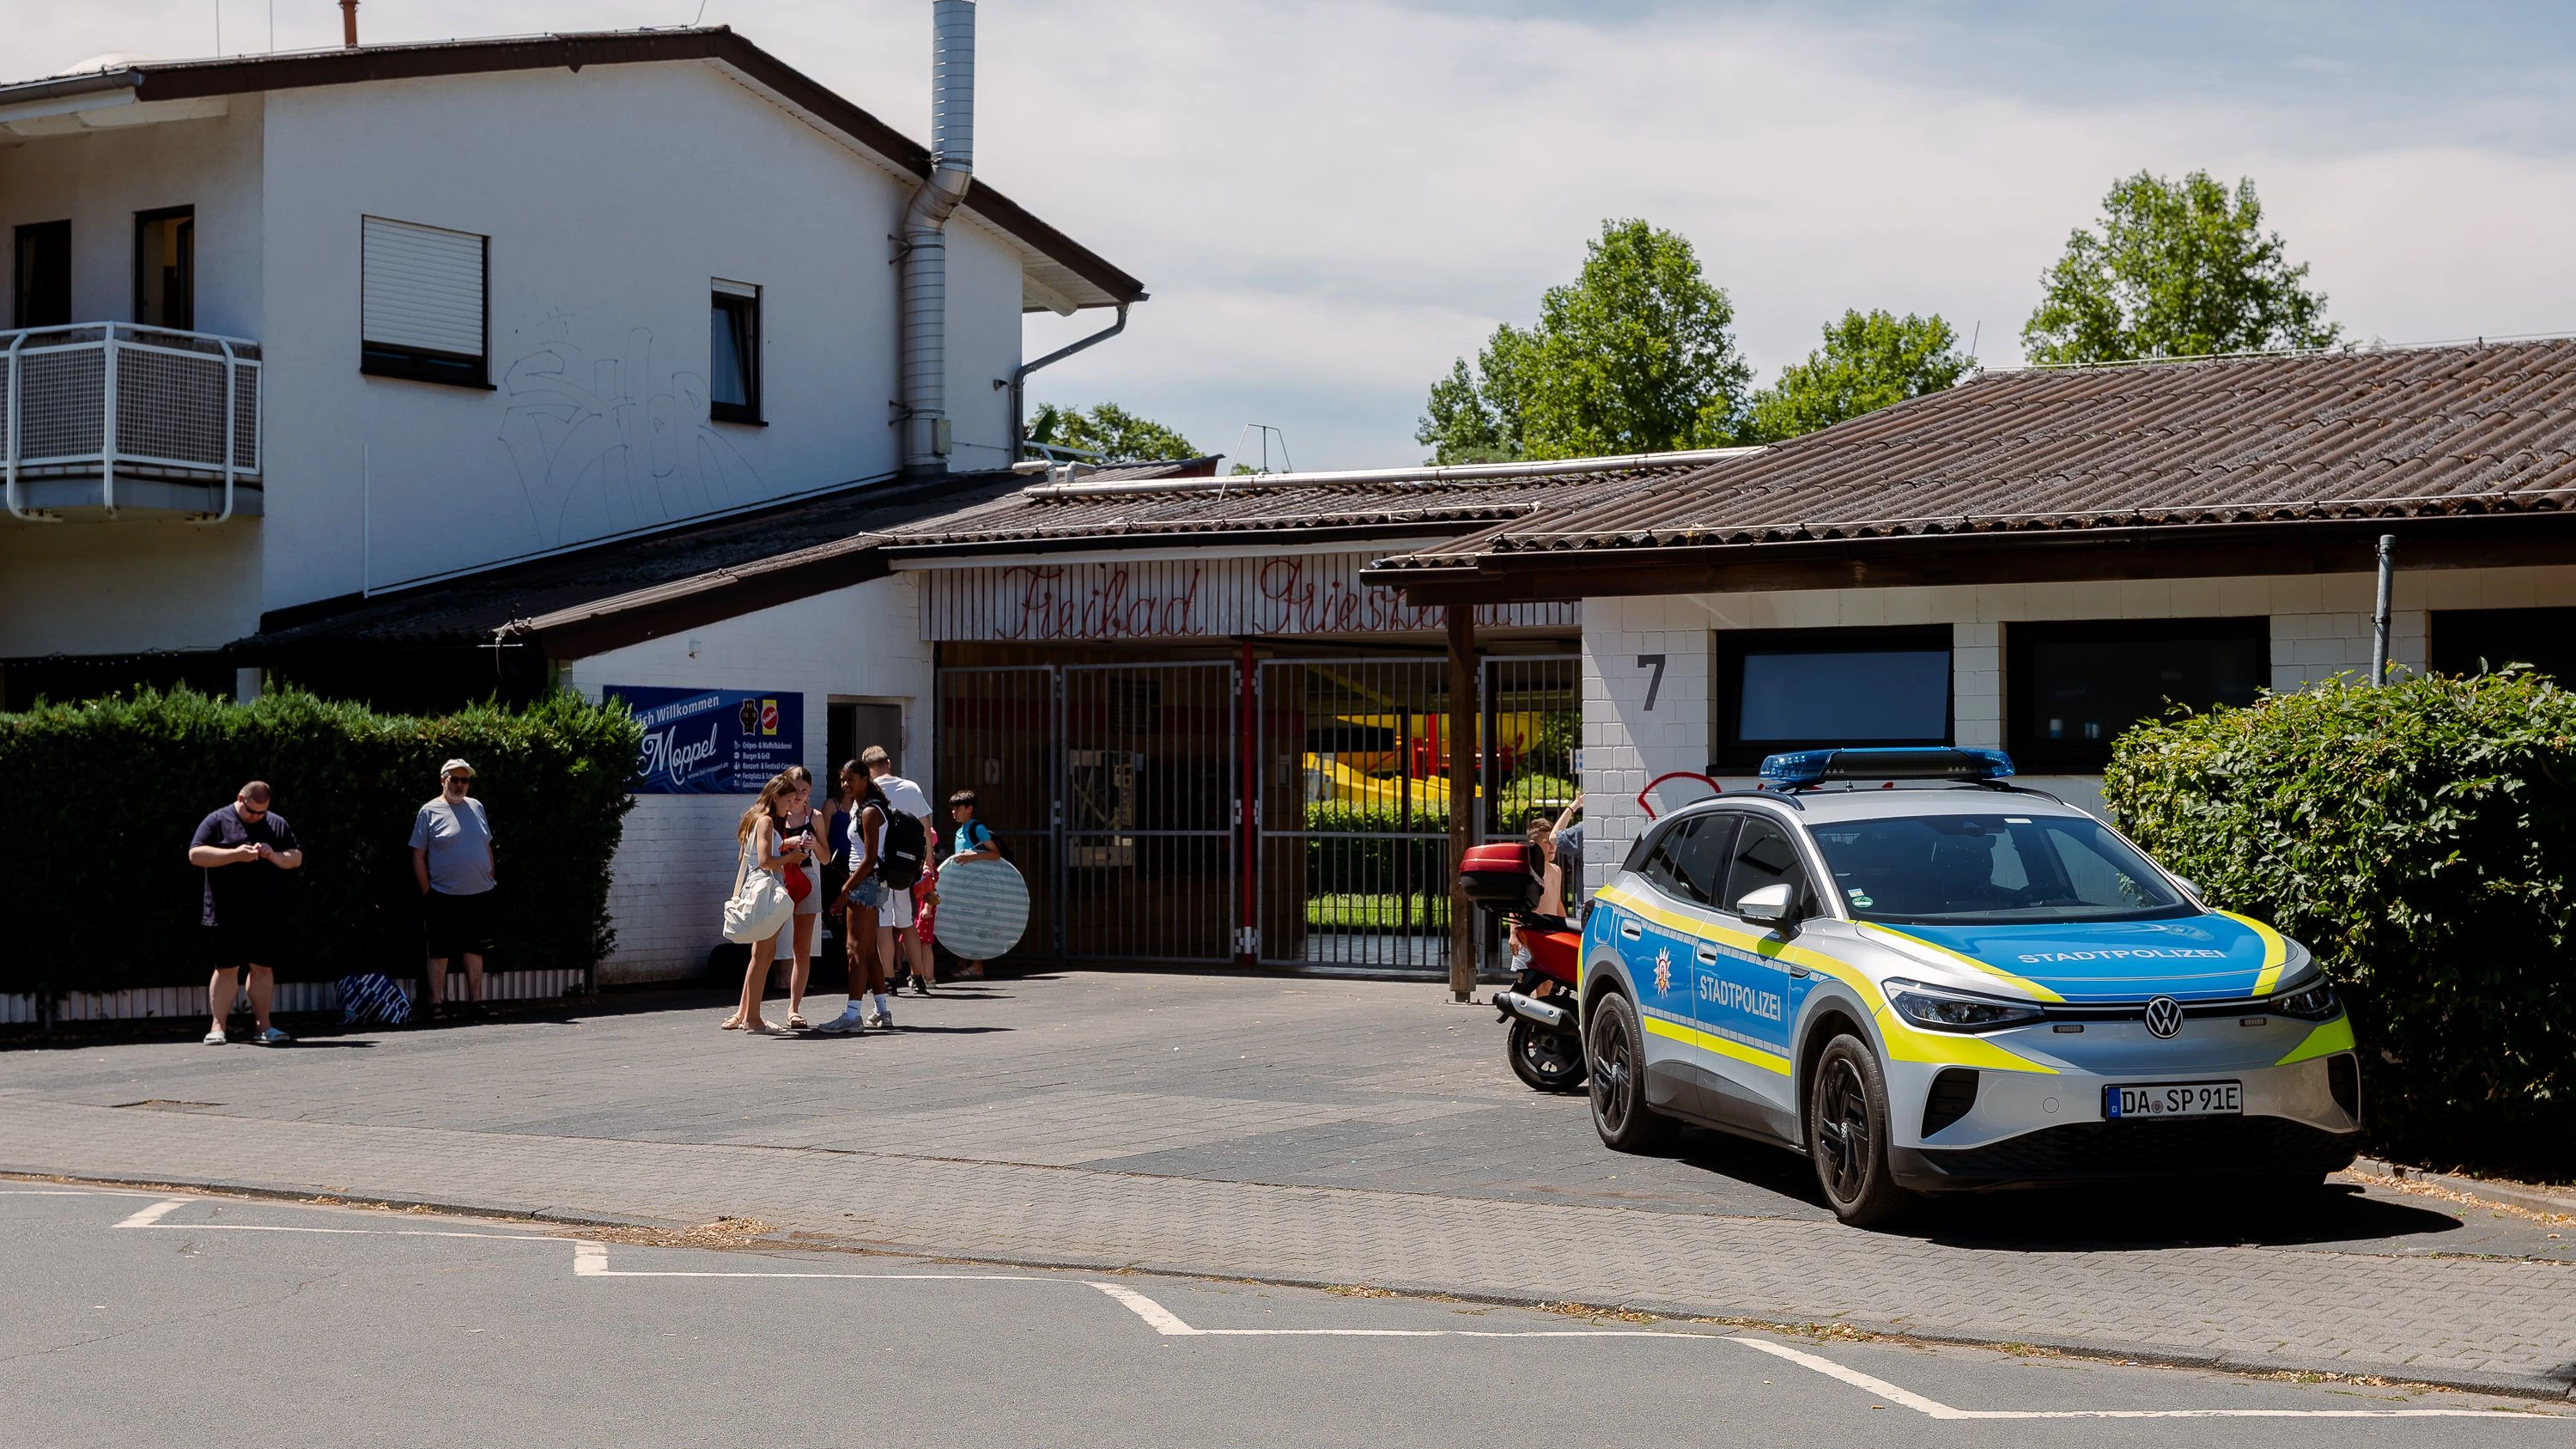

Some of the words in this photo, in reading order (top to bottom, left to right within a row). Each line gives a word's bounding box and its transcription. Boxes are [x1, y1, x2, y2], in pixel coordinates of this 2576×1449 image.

[996, 566, 1204, 640] Freibad
[1637, 654, 1666, 712] 7
[656, 696, 720, 723] Willkommen
[636, 721, 718, 786] Moppel
[762, 752, 770, 760] Grill
[2018, 949, 2227, 964] STADTPOLIZEI
[1700, 975, 1781, 1021] STADTPOLIZEI
[2121, 1090, 2151, 1114] DA
[2166, 1089, 2194, 1112] SP
[2199, 1087, 2239, 1111] 91E
